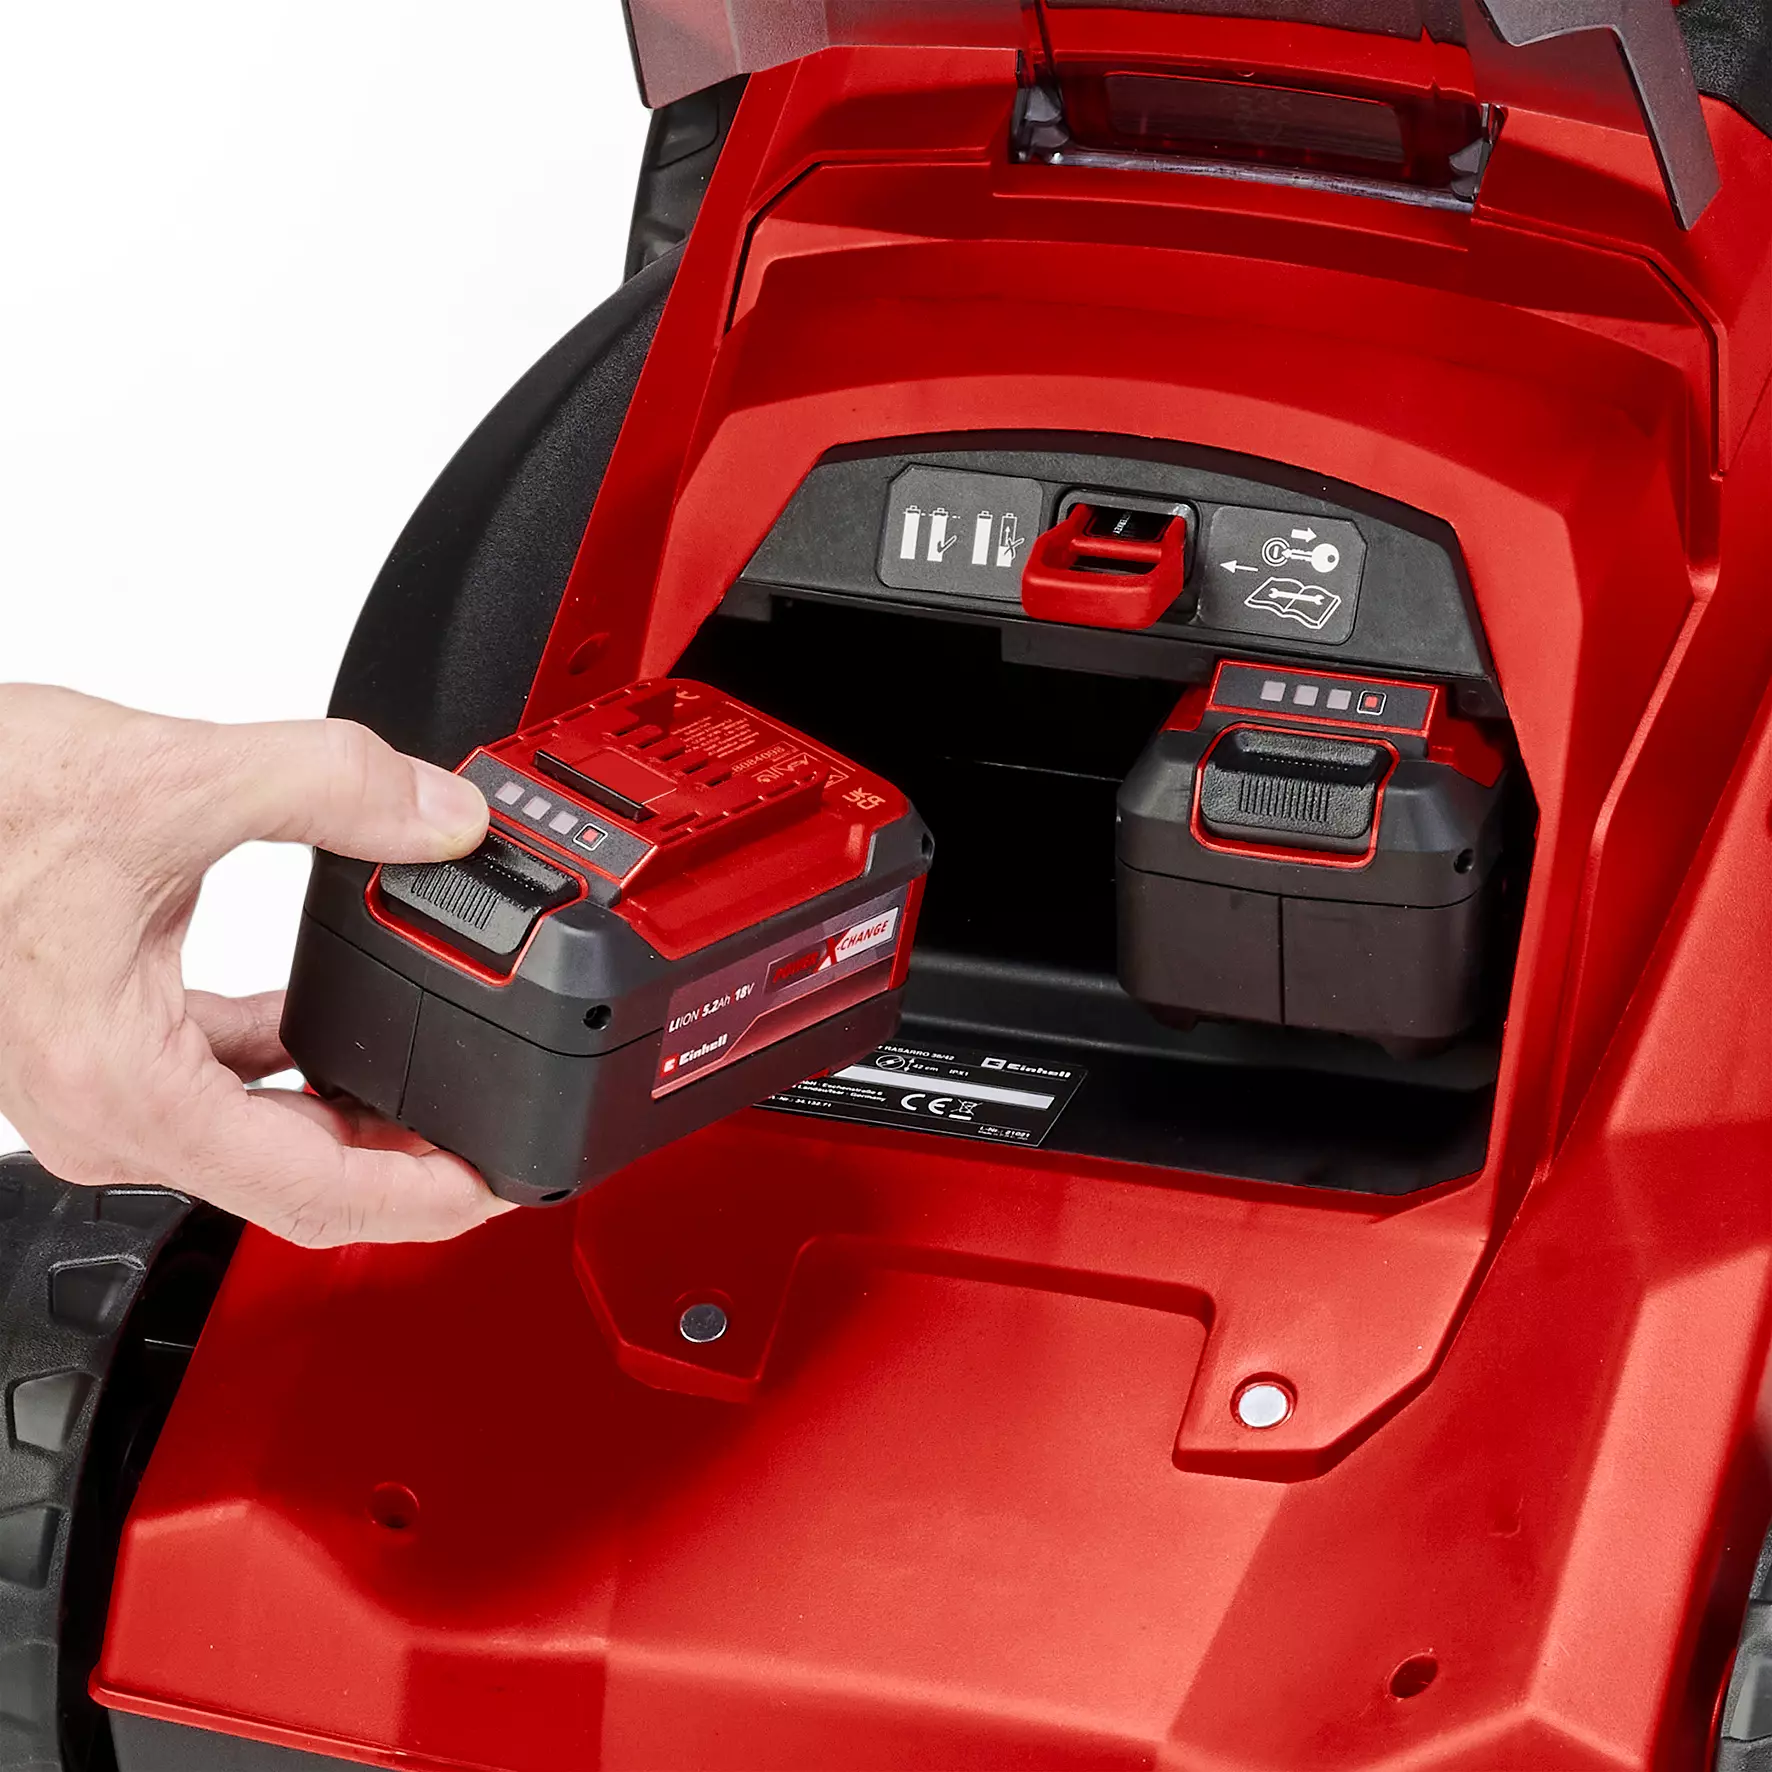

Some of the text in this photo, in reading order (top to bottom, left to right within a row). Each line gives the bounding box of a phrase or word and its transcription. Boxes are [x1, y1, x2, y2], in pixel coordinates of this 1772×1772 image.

[772, 951, 819, 984] POWER
[701, 994, 731, 1018] 5.2Ah
[735, 982, 755, 1001] 18V
[678, 1033, 728, 1066] Einhell
[884, 1045, 930, 1057] RASARRO
[1006, 1062, 1071, 1078] Einhell
[850, 1092, 886, 1102] Germany
